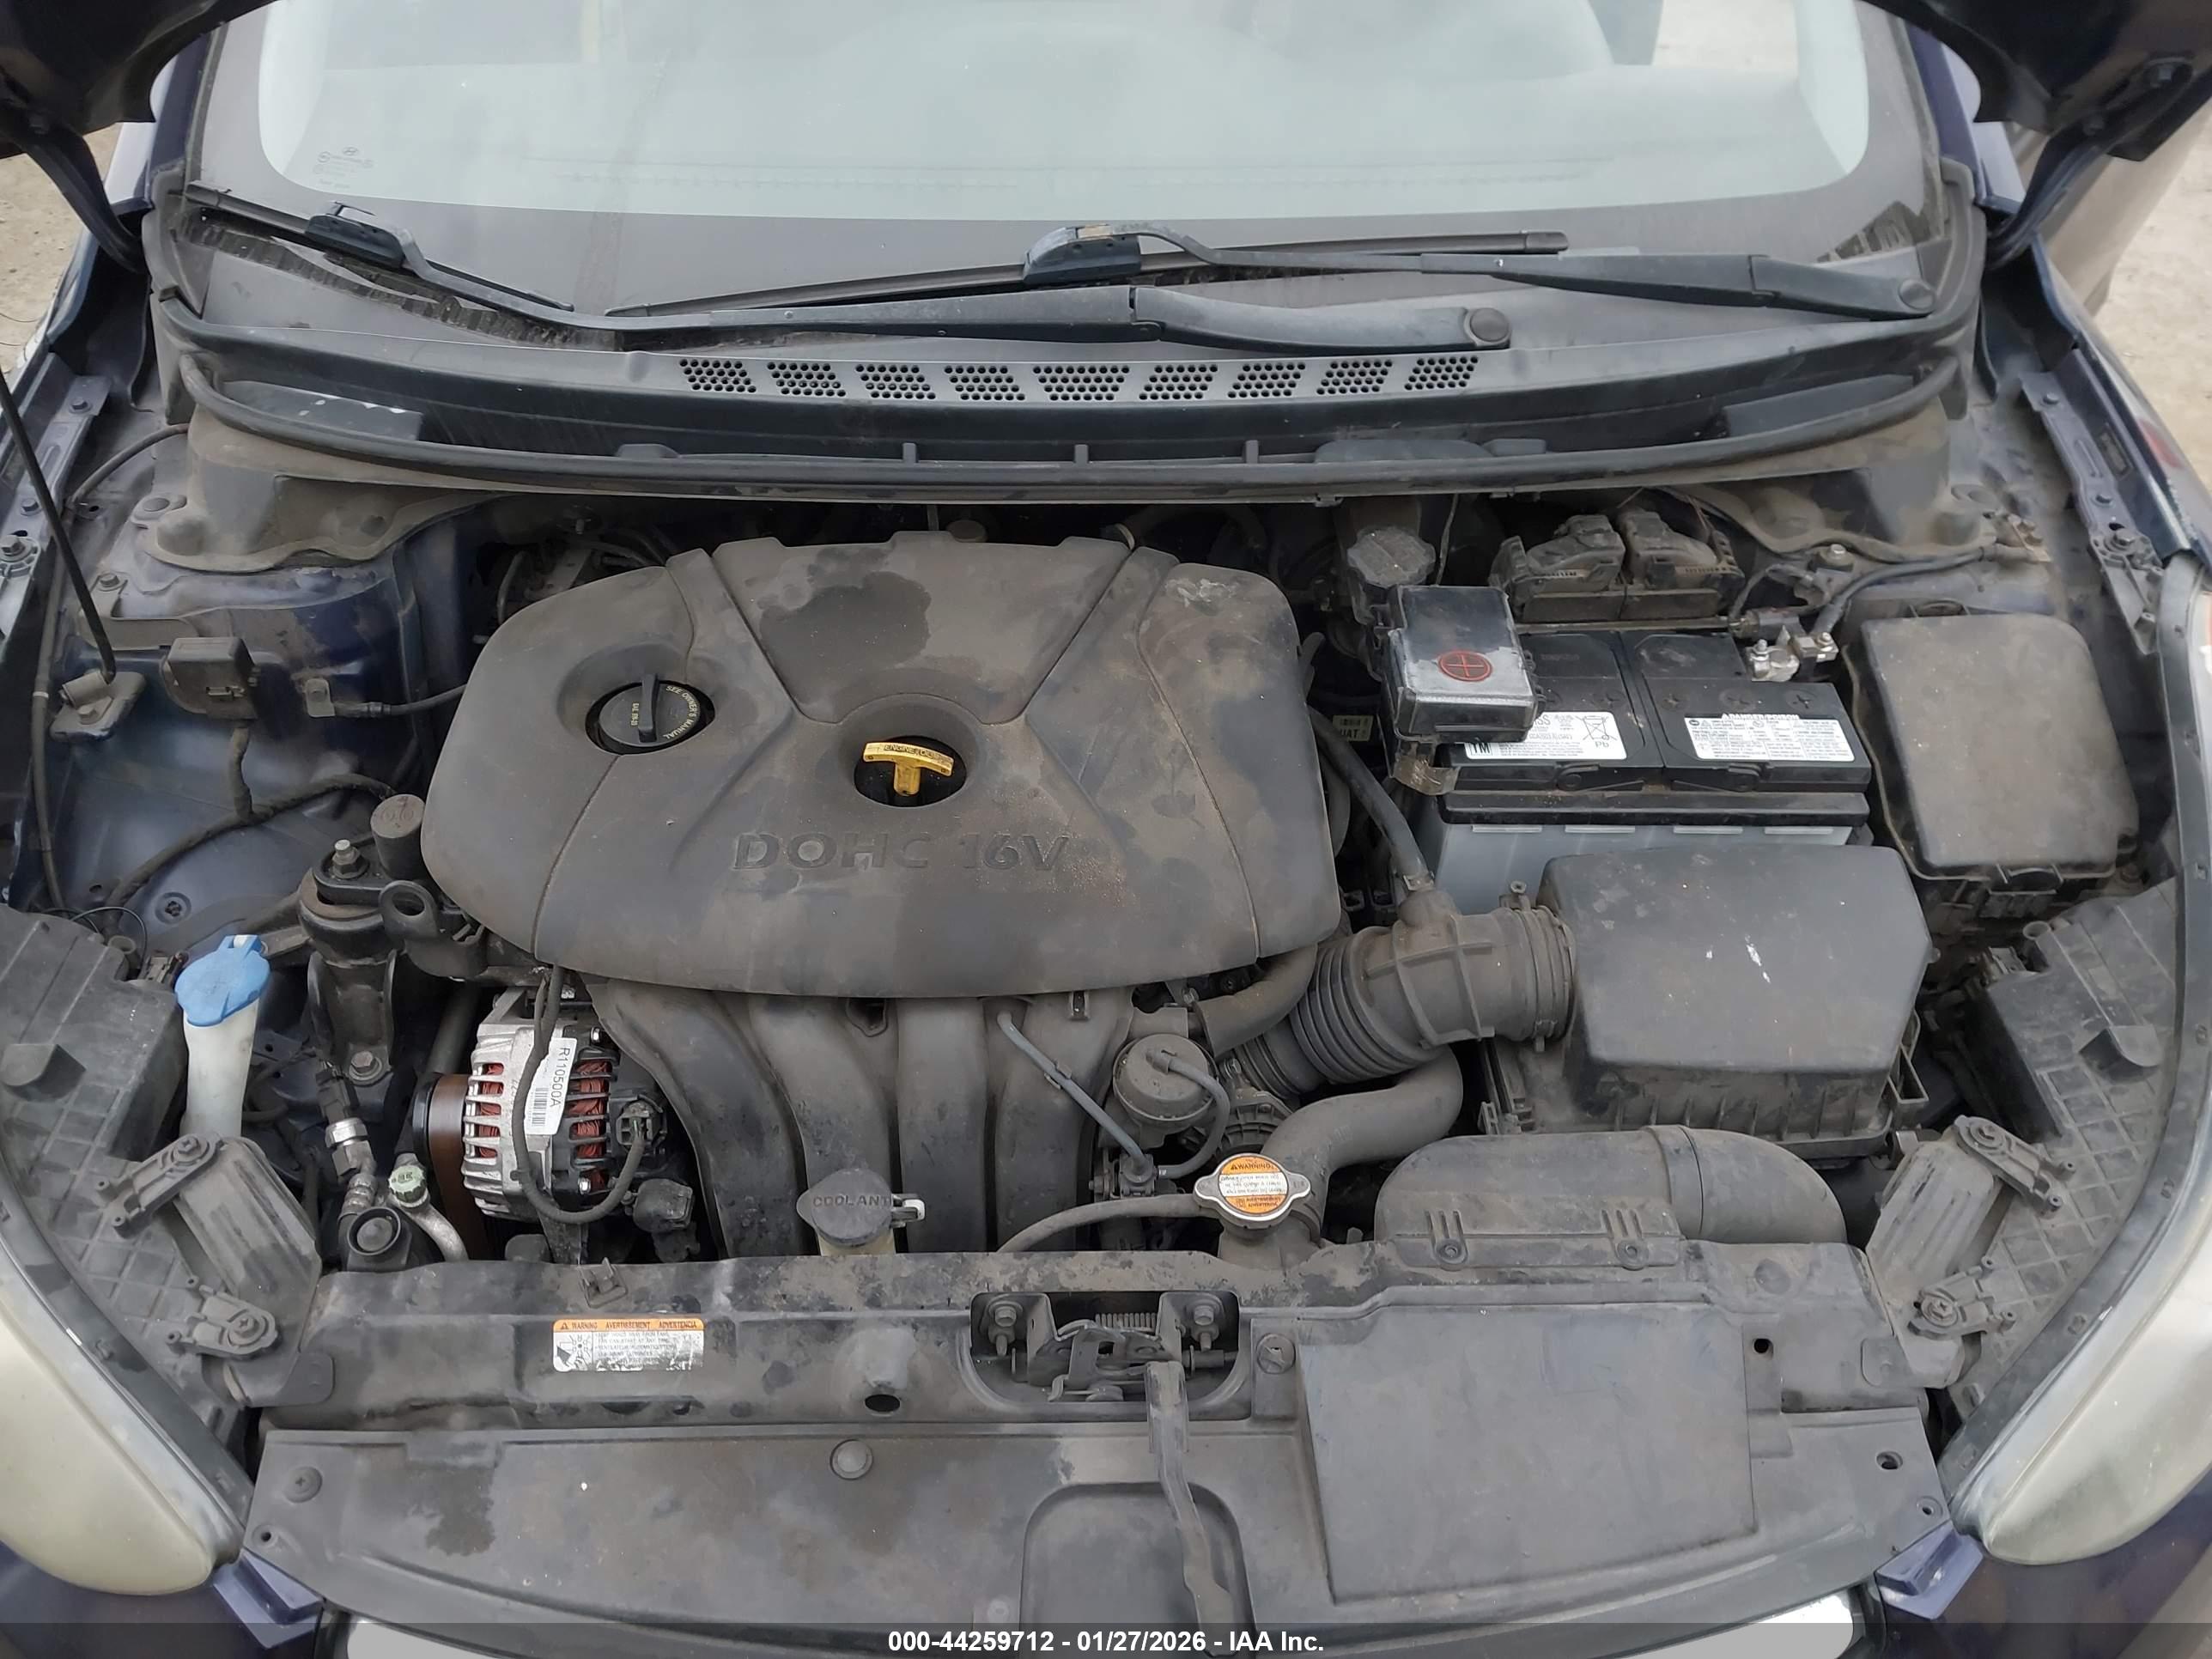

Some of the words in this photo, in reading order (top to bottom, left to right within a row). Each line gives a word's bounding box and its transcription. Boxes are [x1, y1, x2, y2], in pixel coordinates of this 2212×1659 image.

[665, 685, 683, 695] SEE
[681, 692, 697, 721] OWNER'S
[663, 719, 695, 739] MANUAL
[884, 744, 915, 755] ENGINE
[732, 832, 933, 870] DOHC
[959, 833, 1071, 871] 16V
[550, 1048, 571, 1108] R110500A
[812, 1193, 892, 1208] COOLANT
[605, 1322, 651, 1330] AVERTISSEMENT
